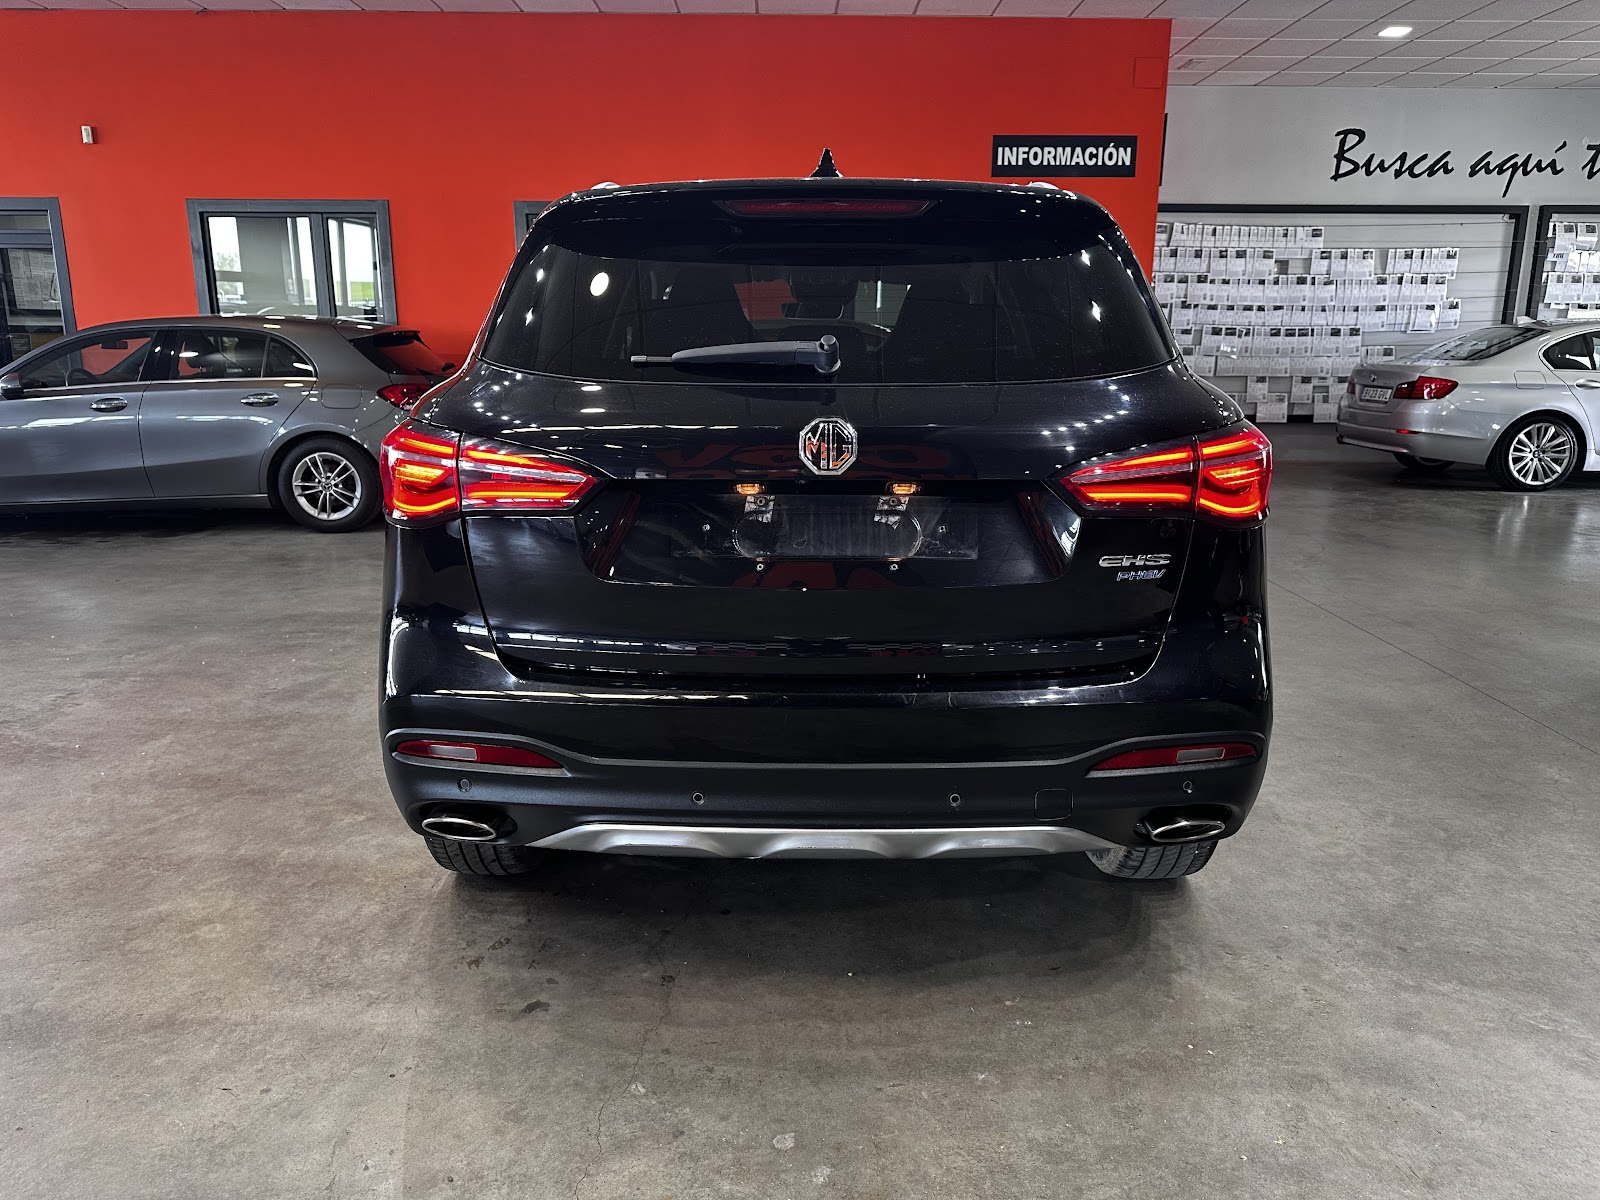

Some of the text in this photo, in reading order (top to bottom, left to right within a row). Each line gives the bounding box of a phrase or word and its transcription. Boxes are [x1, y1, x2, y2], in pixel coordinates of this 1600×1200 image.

[997, 142, 1132, 166] INFORMACIÓN
[1330, 128, 1454, 181] Busca
[1468, 140, 1567, 198] aquí
[803, 421, 853, 470] MG
[1099, 553, 1171, 567] EHS
[1116, 569, 1166, 581] PHEV
